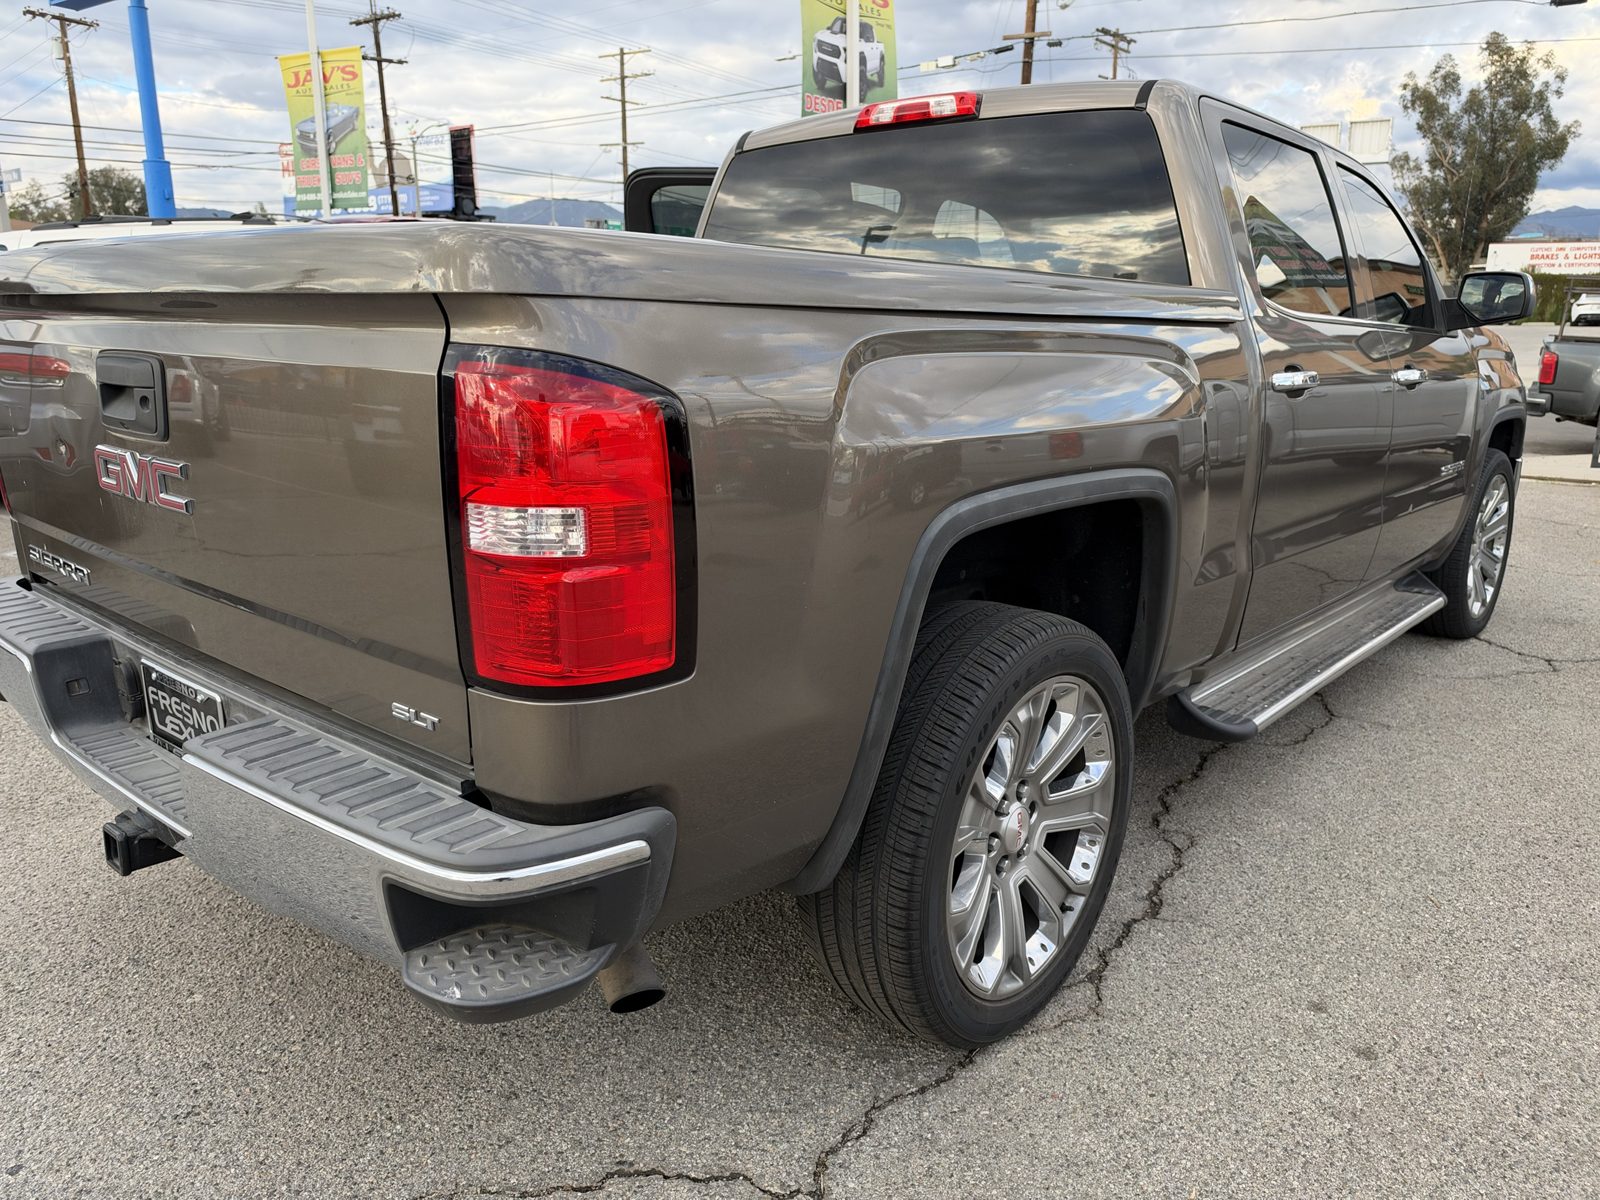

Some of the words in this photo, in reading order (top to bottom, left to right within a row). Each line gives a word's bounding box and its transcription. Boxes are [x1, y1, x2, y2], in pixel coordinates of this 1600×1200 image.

[859, 4, 882, 17] ALES
[287, 65, 359, 88] JAV'S
[356, 153, 365, 167] &
[335, 171, 361, 185] SUV'S
[94, 444, 197, 515] GMC
[27, 543, 92, 587] SIERRA
[156, 671, 197, 700] FRESNO
[147, 685, 220, 734] FRESNO
[152, 707, 196, 742] LEX
[391, 701, 441, 732] SLT
